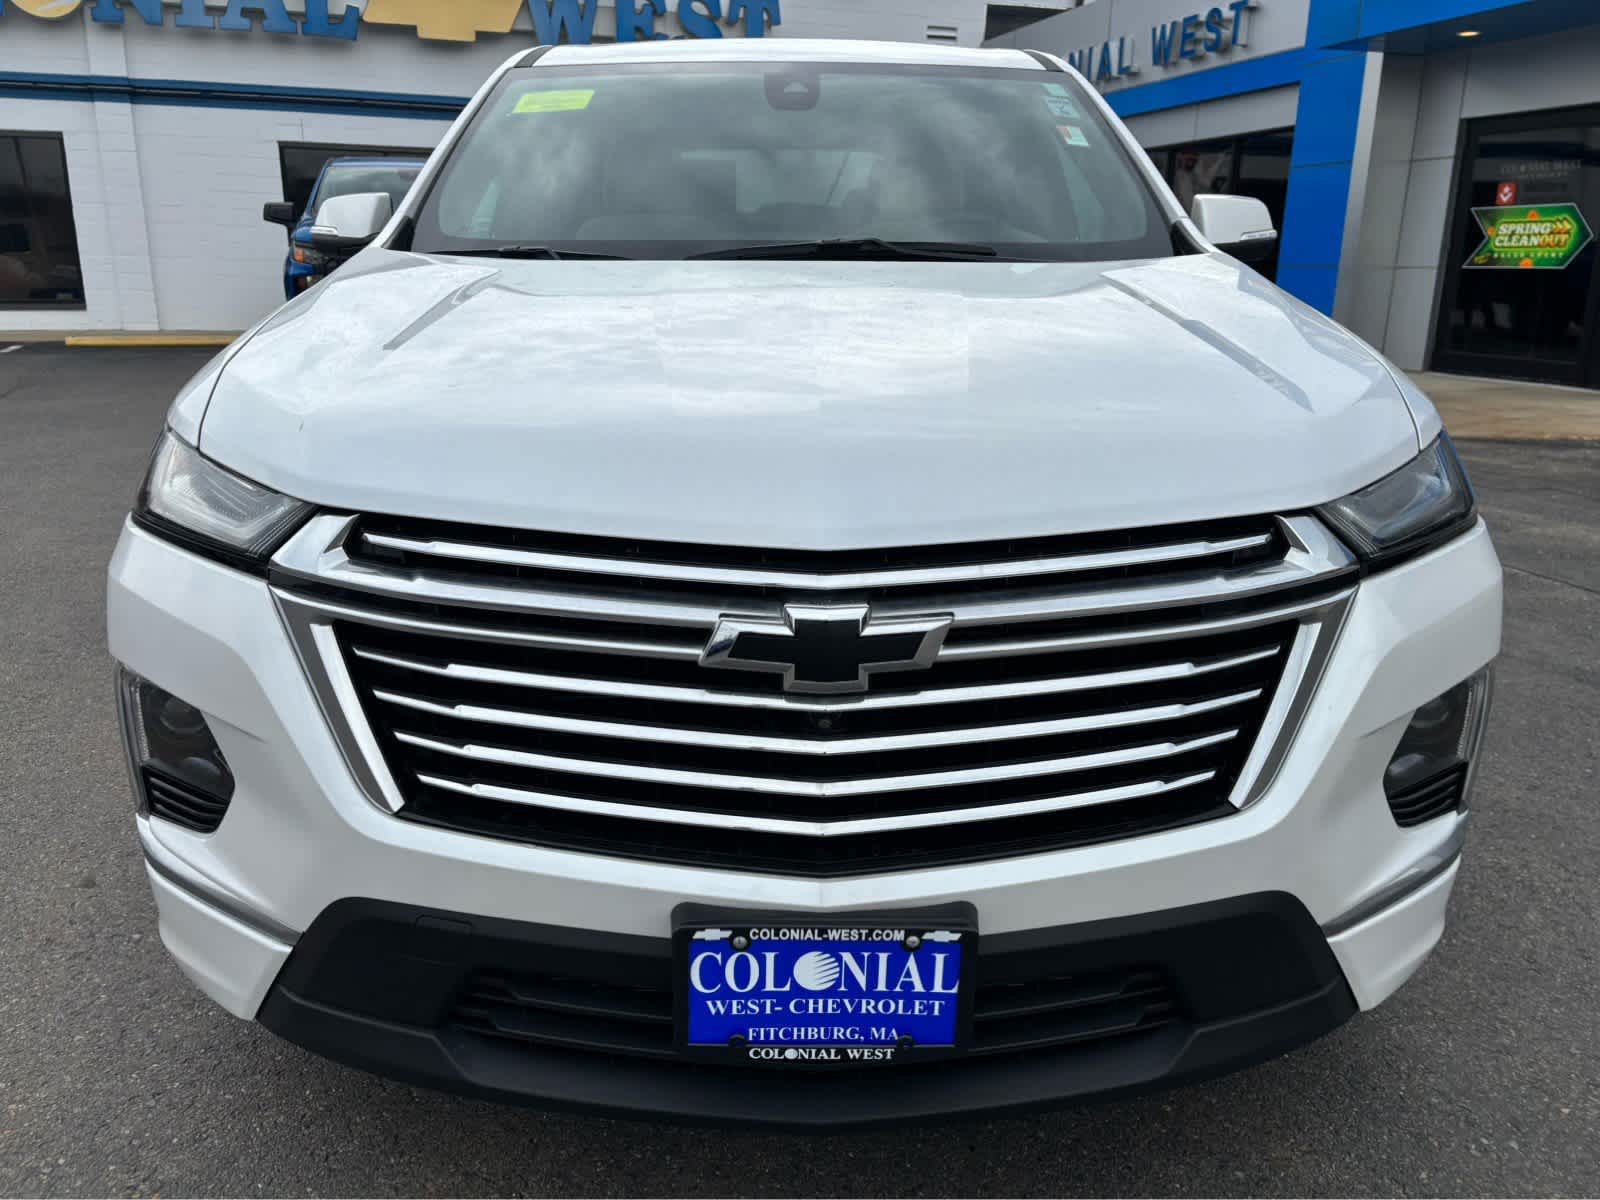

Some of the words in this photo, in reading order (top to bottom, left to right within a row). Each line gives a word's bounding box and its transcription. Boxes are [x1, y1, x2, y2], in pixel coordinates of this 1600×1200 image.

[528, 0, 781, 44] WEST
[1151, 0, 1248, 66] WEST
[1499, 222, 1552, 234] SPRING
[1495, 234, 1569, 248] CLEANOUT
[749, 928, 905, 941] COLONIAL-WEST.COM
[690, 951, 960, 993] COLONIAL
[789, 999, 945, 1016] CHEVROLET
[748, 1027, 865, 1042] FITCHBURG,
[870, 1028, 899, 1040] MA
[749, 1048, 841, 1060] COLONIAL
[848, 1048, 895, 1060] WEST
